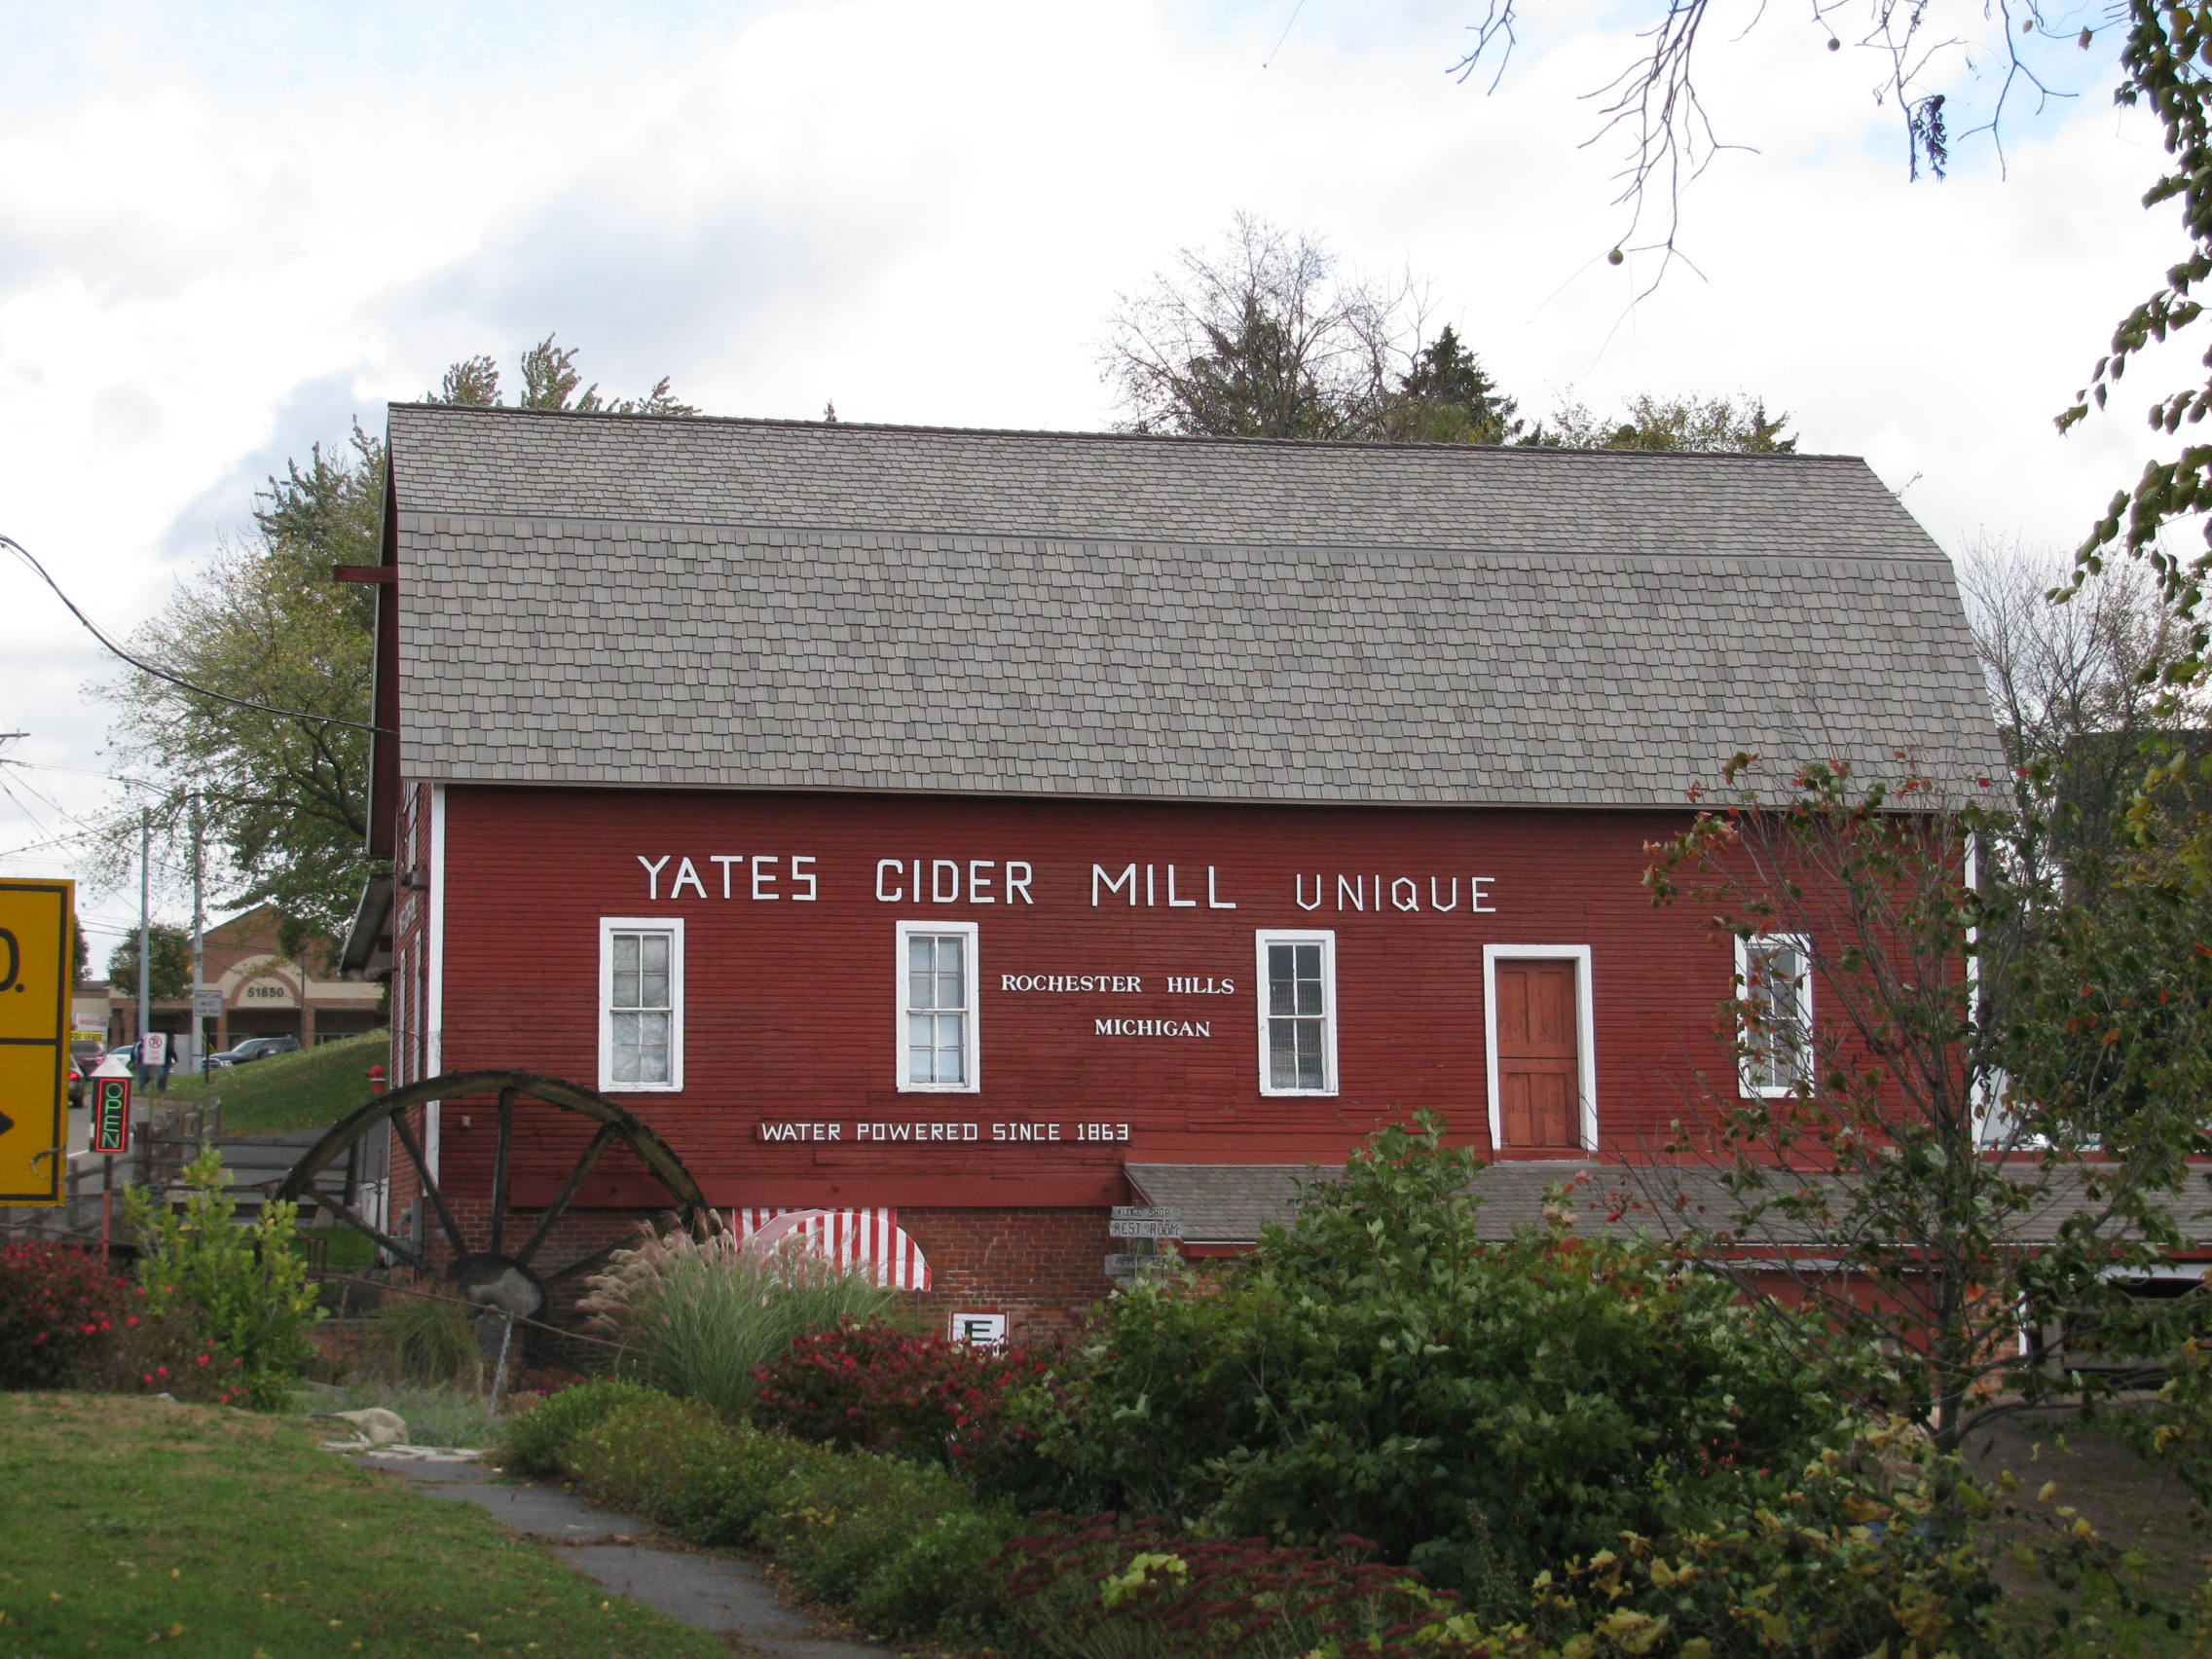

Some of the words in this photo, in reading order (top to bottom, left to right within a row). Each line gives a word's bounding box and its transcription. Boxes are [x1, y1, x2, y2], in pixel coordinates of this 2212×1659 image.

[637, 855, 817, 901] YATES
[876, 859, 1034, 903] CIDER
[1091, 863, 1236, 908] MILL
[1296, 873, 1496, 912] UNIQUE
[1001, 975, 1142, 992] ROCHESTER
[1166, 977, 1235, 994] HILLS
[1094, 1018, 1211, 1037] MICHIGAN
[101, 1083, 123, 1149] OPEN
[761, 1124, 841, 1140] WATER
[857, 1124, 978, 1141] POWERED
[992, 1124, 1060, 1141] SINCE
[1077, 1124, 1129, 1141] 1863
[1149, 1207, 1170, 1217] SHOP
[1114, 1223, 1141, 1235] REST
[1150, 1223, 1179, 1235] ROOM
[964, 1319, 993, 1342] E
